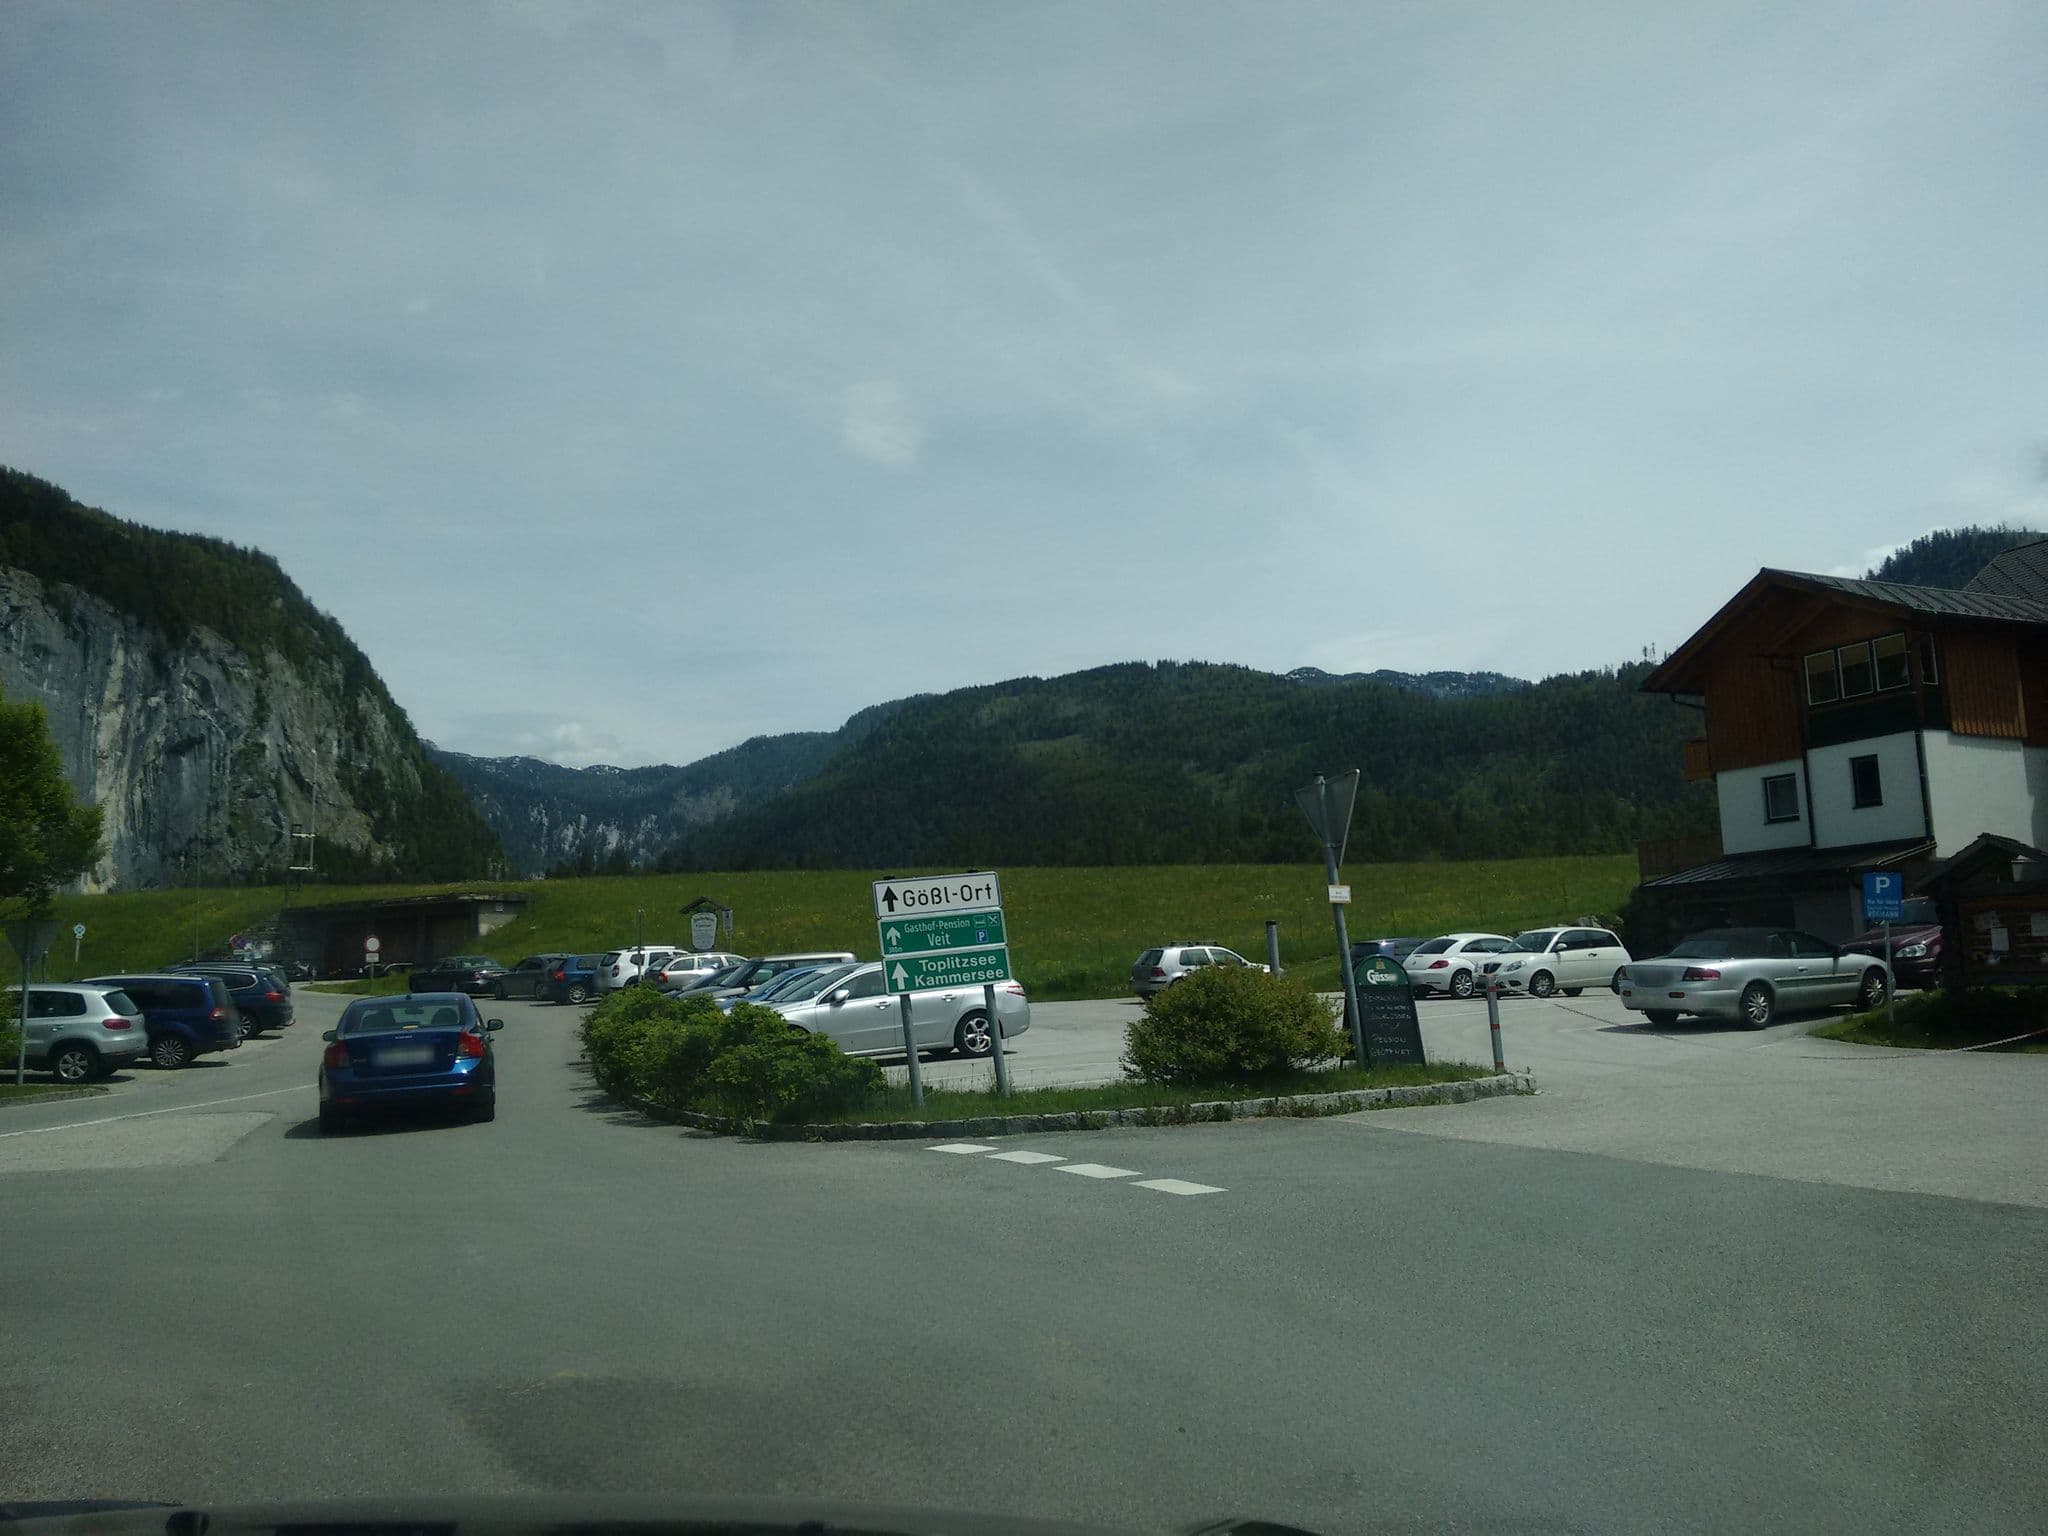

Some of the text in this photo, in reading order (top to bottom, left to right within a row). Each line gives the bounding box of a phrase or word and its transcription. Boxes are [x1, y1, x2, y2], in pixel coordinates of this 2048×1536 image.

[1876, 877, 1890, 893] P
[903, 883, 992, 907] Gößl-Ort
[904, 918, 970, 933] Gasthof-Pension
[927, 932, 951, 946] Veit
[919, 955, 996, 973] Toplitzsee
[915, 969, 1004, 987] Kammersee
